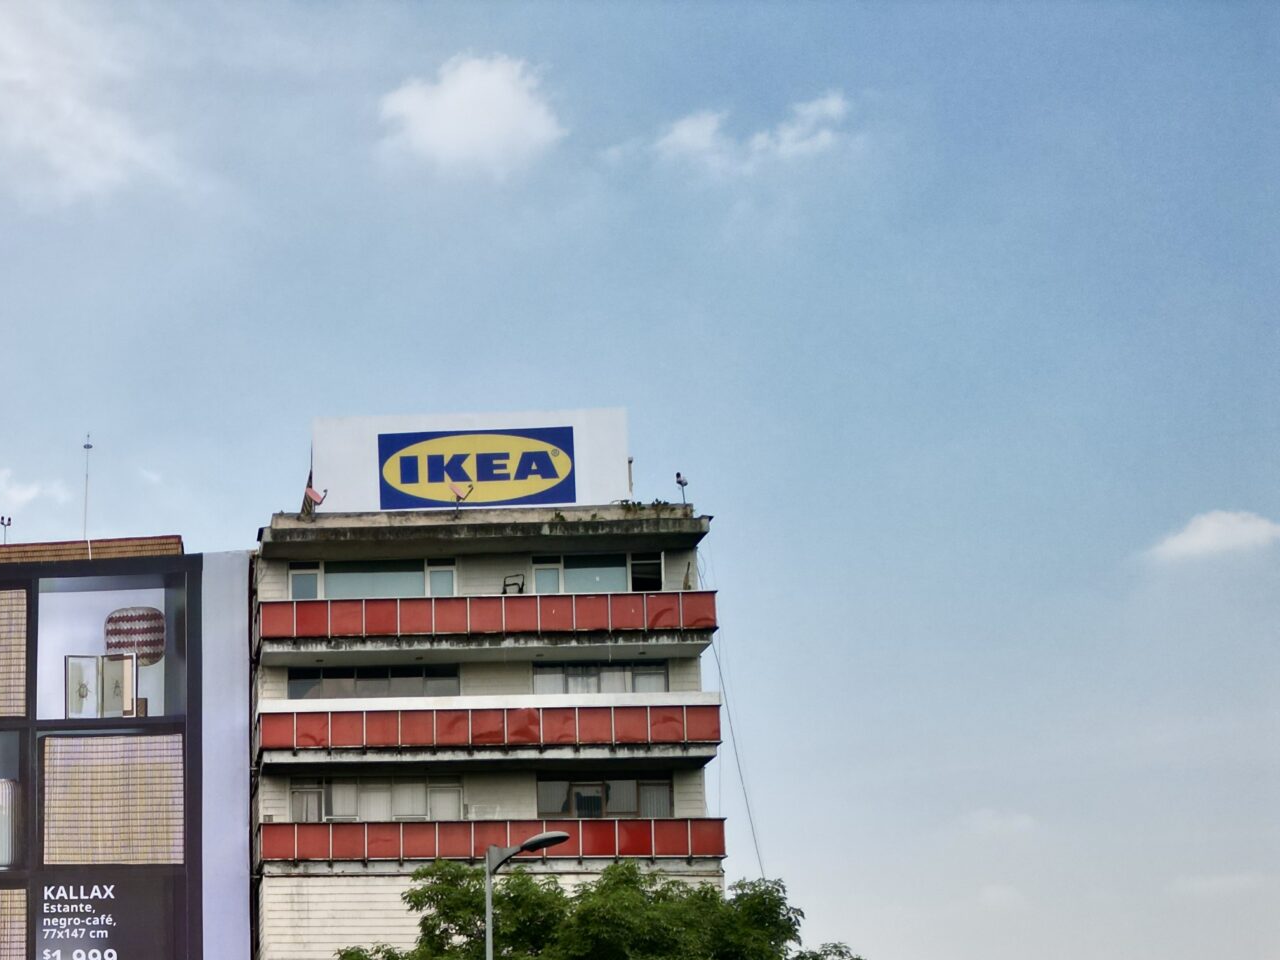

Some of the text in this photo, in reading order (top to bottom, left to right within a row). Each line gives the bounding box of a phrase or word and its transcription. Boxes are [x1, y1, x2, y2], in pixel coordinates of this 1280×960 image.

[399, 450, 560, 485] IKEA
[43, 885, 115, 900] KALLAX
[43, 903, 96, 914] Estante,
[43, 914, 117, 928] negro-café,
[43, 928, 109, 939] 77x147 cm
